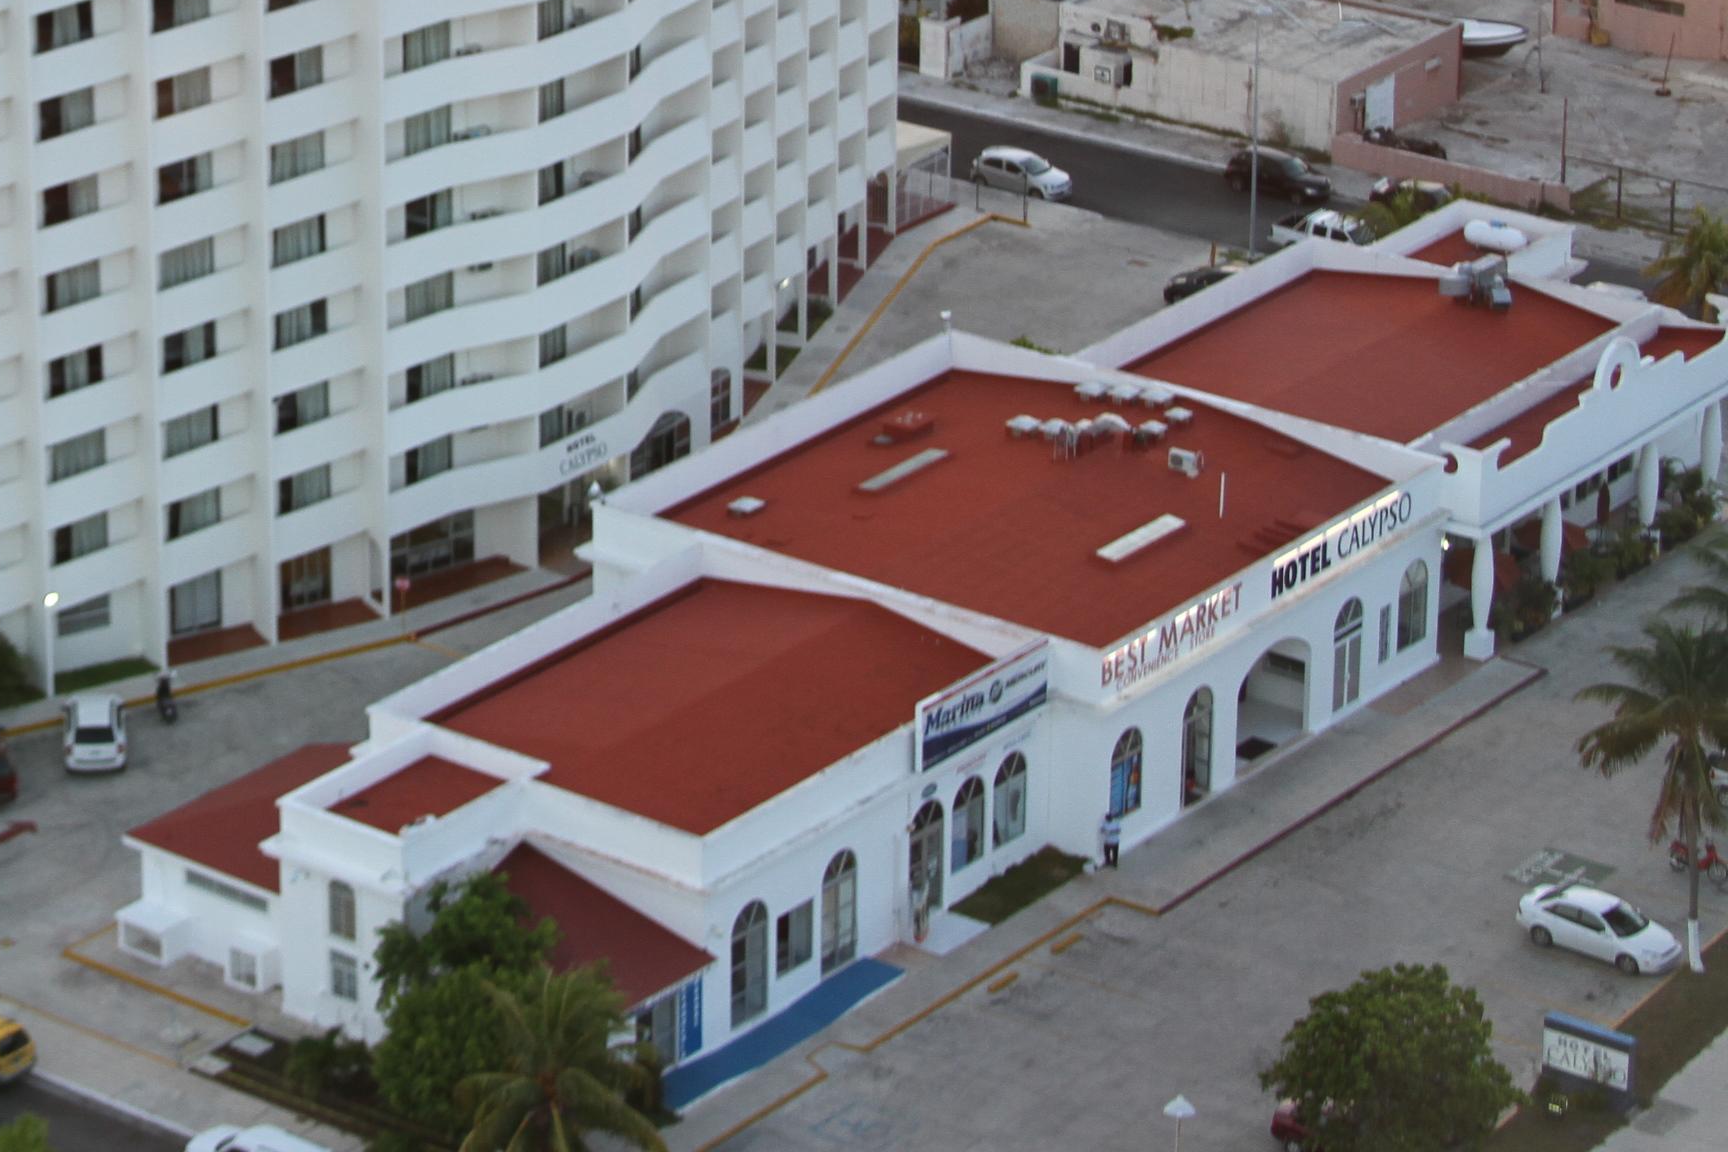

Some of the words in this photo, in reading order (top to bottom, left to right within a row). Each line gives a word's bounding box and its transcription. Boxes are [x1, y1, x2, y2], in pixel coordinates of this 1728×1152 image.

[559, 441, 608, 476] CALYPSO
[566, 433, 596, 453] HOTEL
[1271, 541, 1331, 600] HOTEL
[1338, 491, 1412, 559] CALYPSO
[1101, 636, 1149, 688] BEST
[1158, 582, 1243, 655] MARKET
[1116, 646, 1179, 692] CONVENIENCE
[1190, 623, 1216, 649] STORE
[924, 691, 985, 736] Marina
[1557, 1034, 1608, 1061] HOTEL
